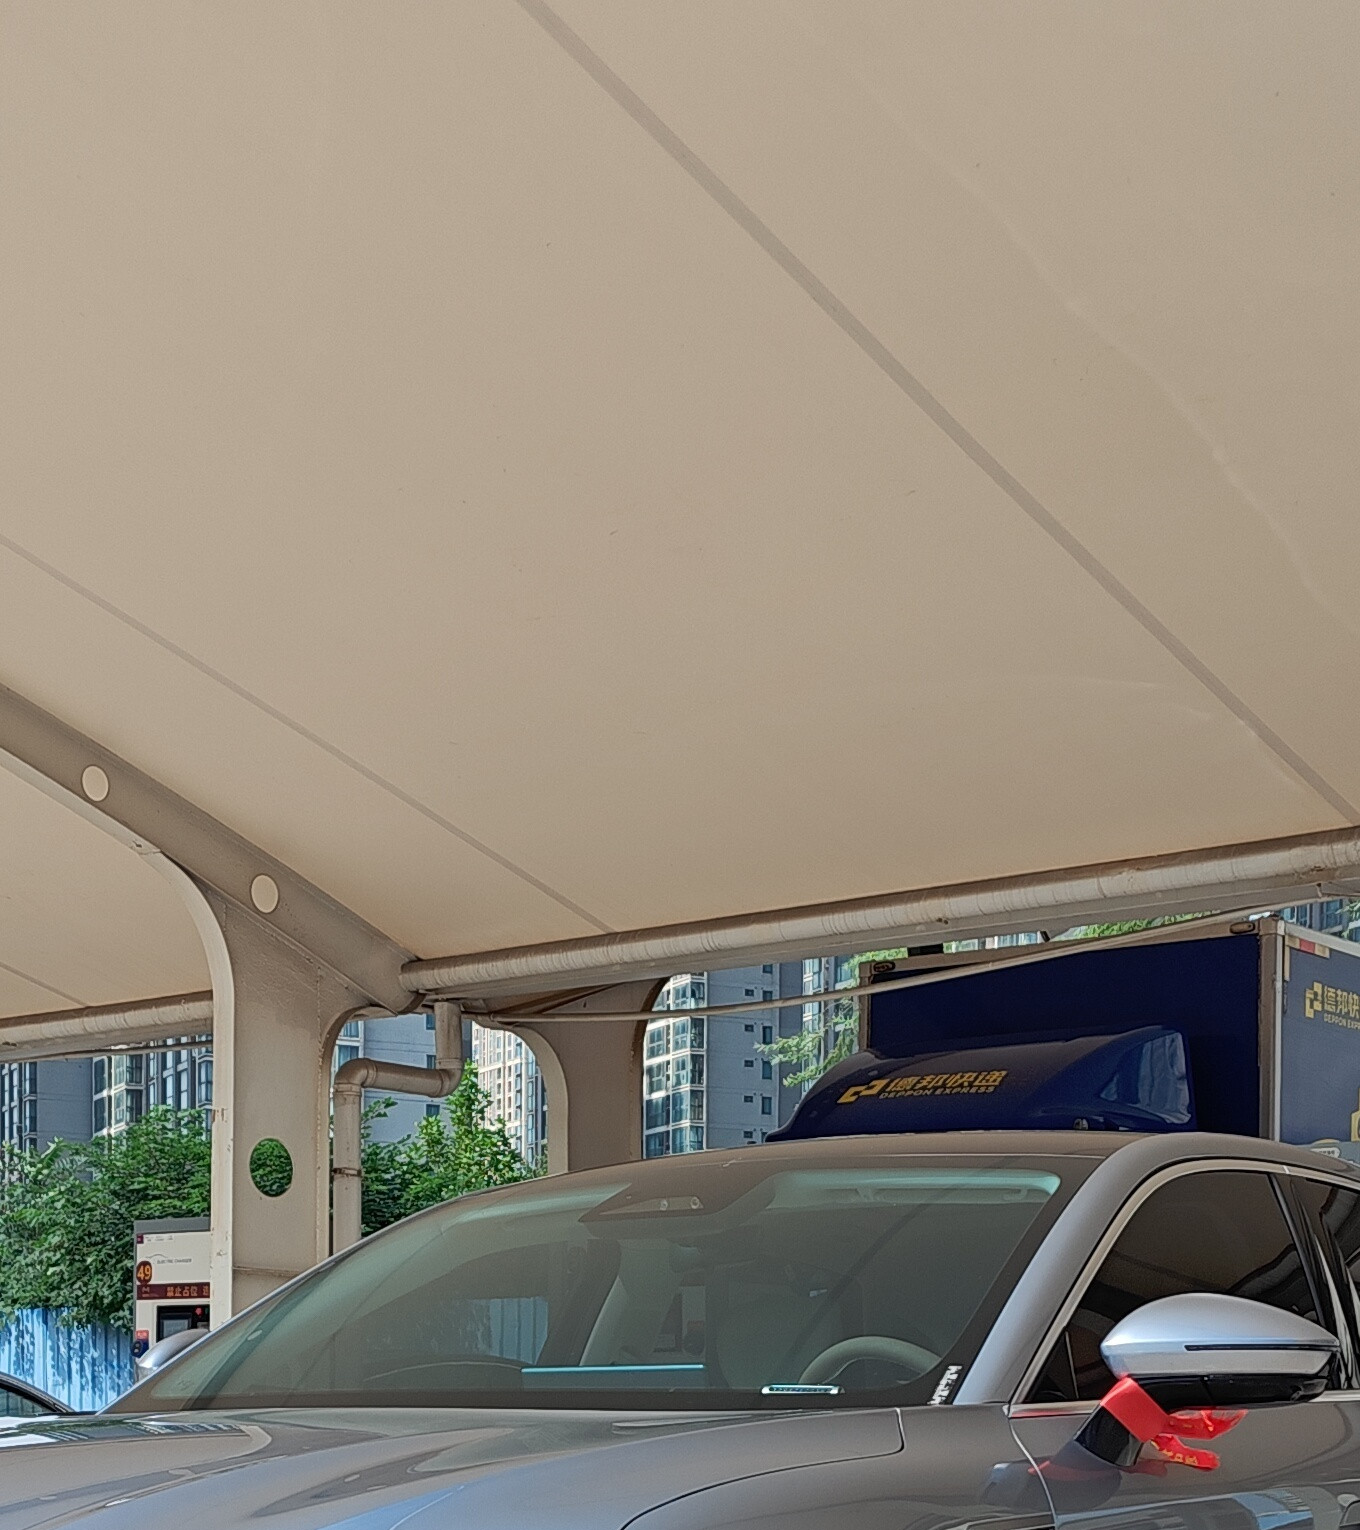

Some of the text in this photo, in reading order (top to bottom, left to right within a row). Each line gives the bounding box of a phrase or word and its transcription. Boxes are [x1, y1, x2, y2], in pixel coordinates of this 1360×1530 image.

[885, 1070, 1008, 1092] 德邦快递
[879, 1085, 996, 1099] DEPPON EXPRESS
[137, 1265, 151, 1280] 49
